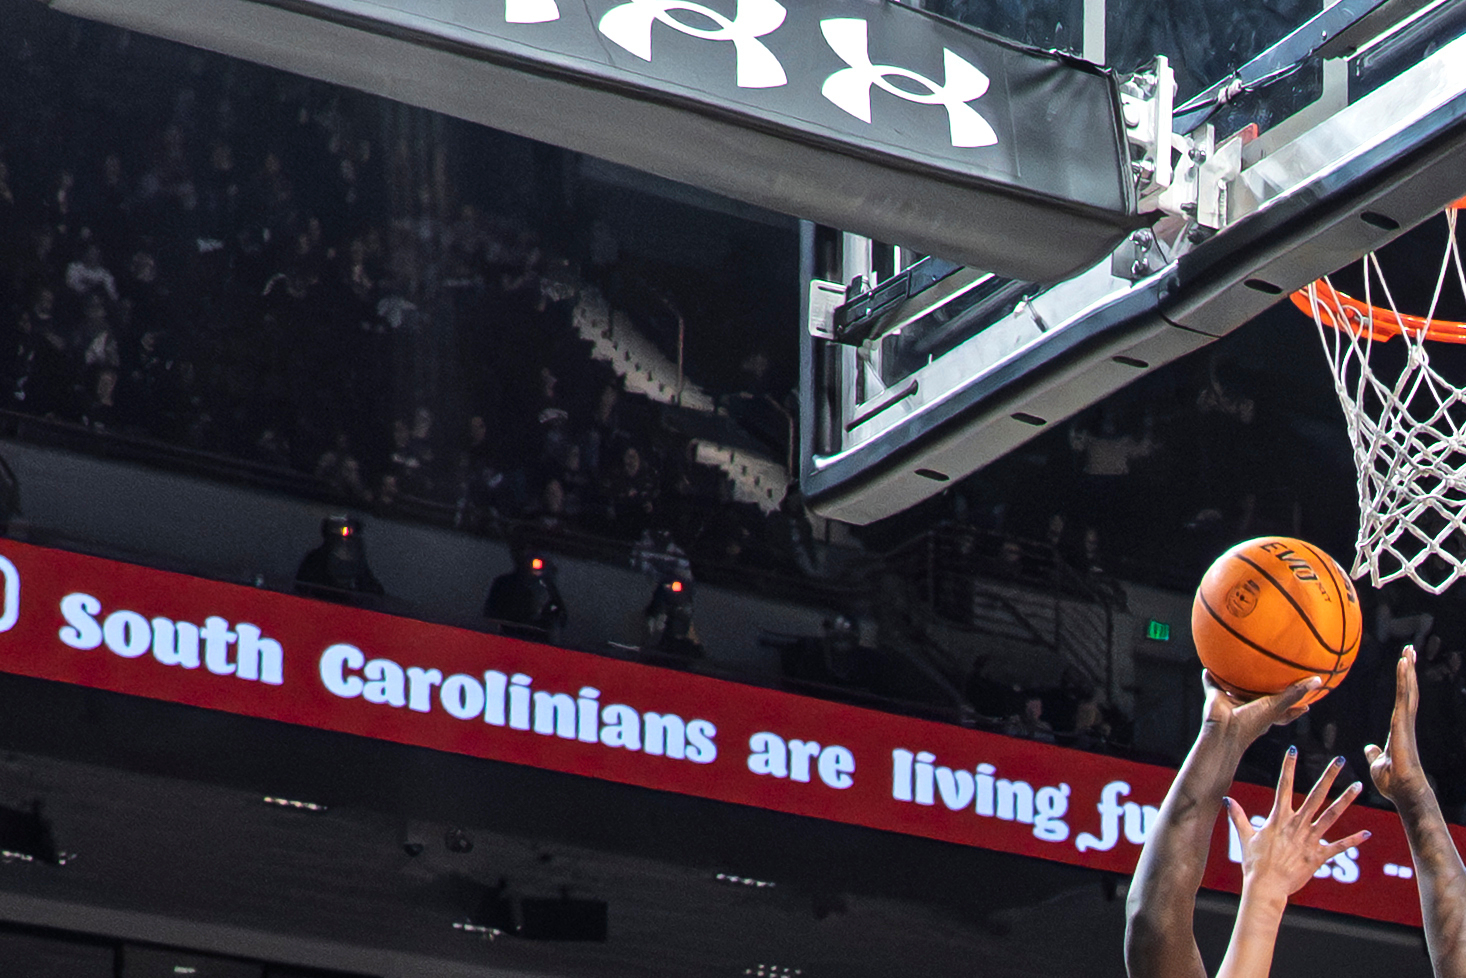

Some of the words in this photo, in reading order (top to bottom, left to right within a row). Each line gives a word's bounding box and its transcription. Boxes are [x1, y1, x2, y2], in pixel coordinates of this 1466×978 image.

[58, 592, 284, 686] South
[319, 643, 717, 763] Carolinians
[747, 731, 855, 789] are
[892, 748, 1070, 842] living
